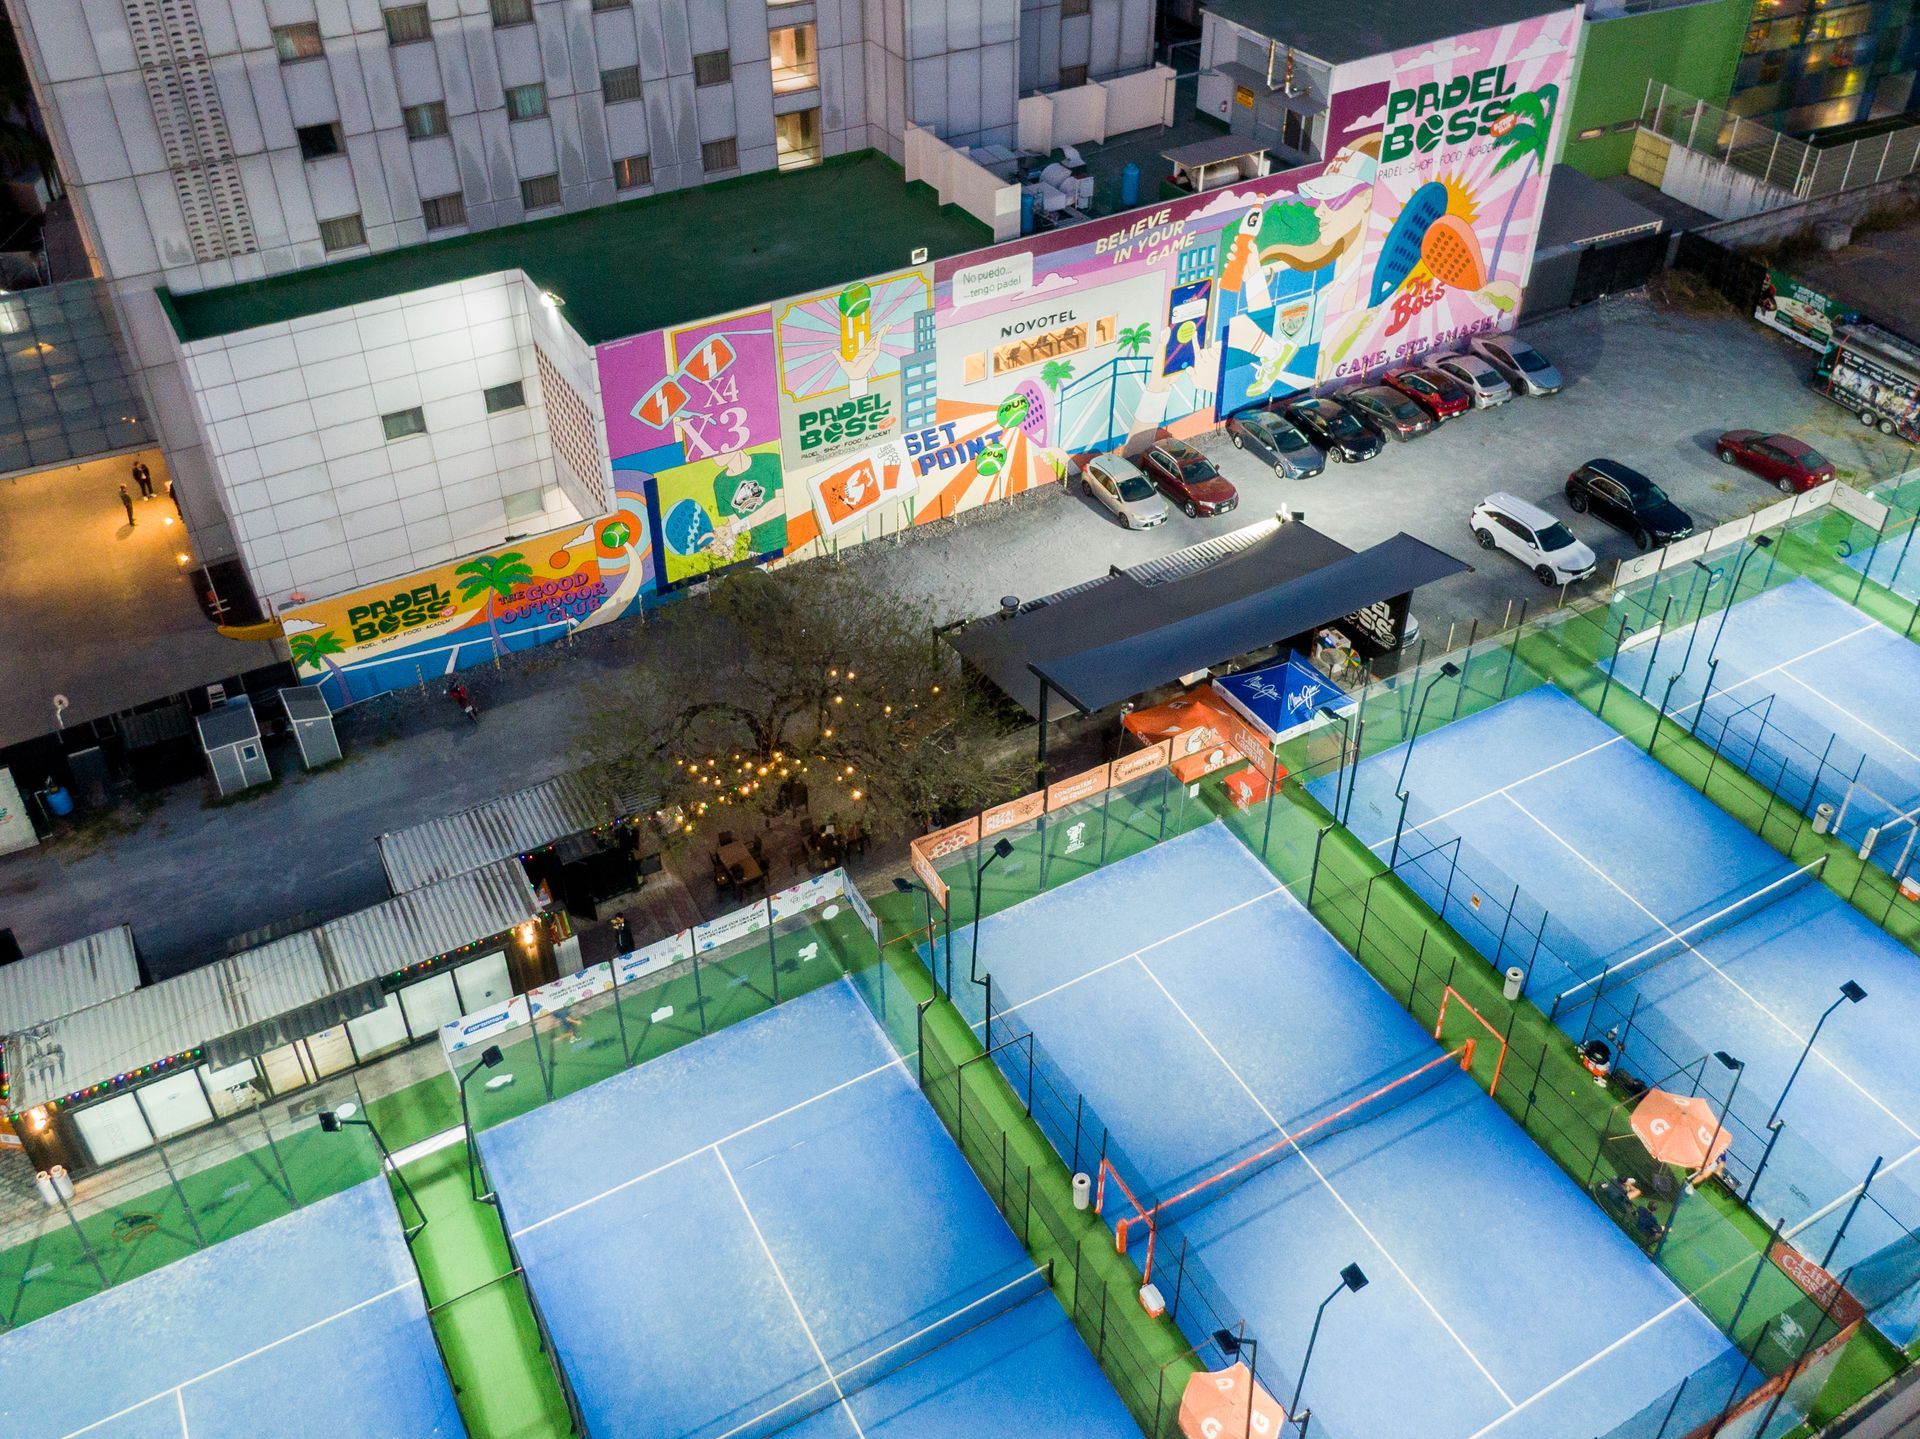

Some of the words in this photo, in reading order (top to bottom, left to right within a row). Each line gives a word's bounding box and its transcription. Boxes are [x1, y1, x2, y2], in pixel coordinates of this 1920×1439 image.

[1387, 64, 1516, 125] PADEL
[1408, 158, 1433, 173] SHOP
[1440, 151, 1462, 165] FOOD
[1095, 208, 1171, 255] BELIEVE
[1113, 246, 1133, 265] IN
[1138, 220, 1185, 255] YOUR
[1146, 231, 1196, 266] GAME
[997, 275, 1021, 291] padel
[1001, 309, 1077, 338] NOVOTEL
[1335, 351, 1390, 378] GAME,
[703, 376, 740, 408] X4
[799, 394, 891, 431] PADEL
[800, 408, 890, 451] BOSS
[679, 407, 751, 462] X3
[823, 444, 841, 453] SHOP
[844, 439, 861, 447] FOOD
[864, 429, 891, 440] ACADEMY
[903, 421, 956, 456] SET
[918, 429, 1003, 476] POINT
[348, 583, 450, 626] PADEL
[502, 582, 607, 623] OUTDOOR
[526, 573, 588, 600] GOOD
[353, 598, 450, 643] BOSS
[357, 642, 377, 651] PADEL
[382, 634, 399, 643] SHOP
[403, 628, 421, 636] FOOD
[426, 618, 453, 629] ACADEMY
